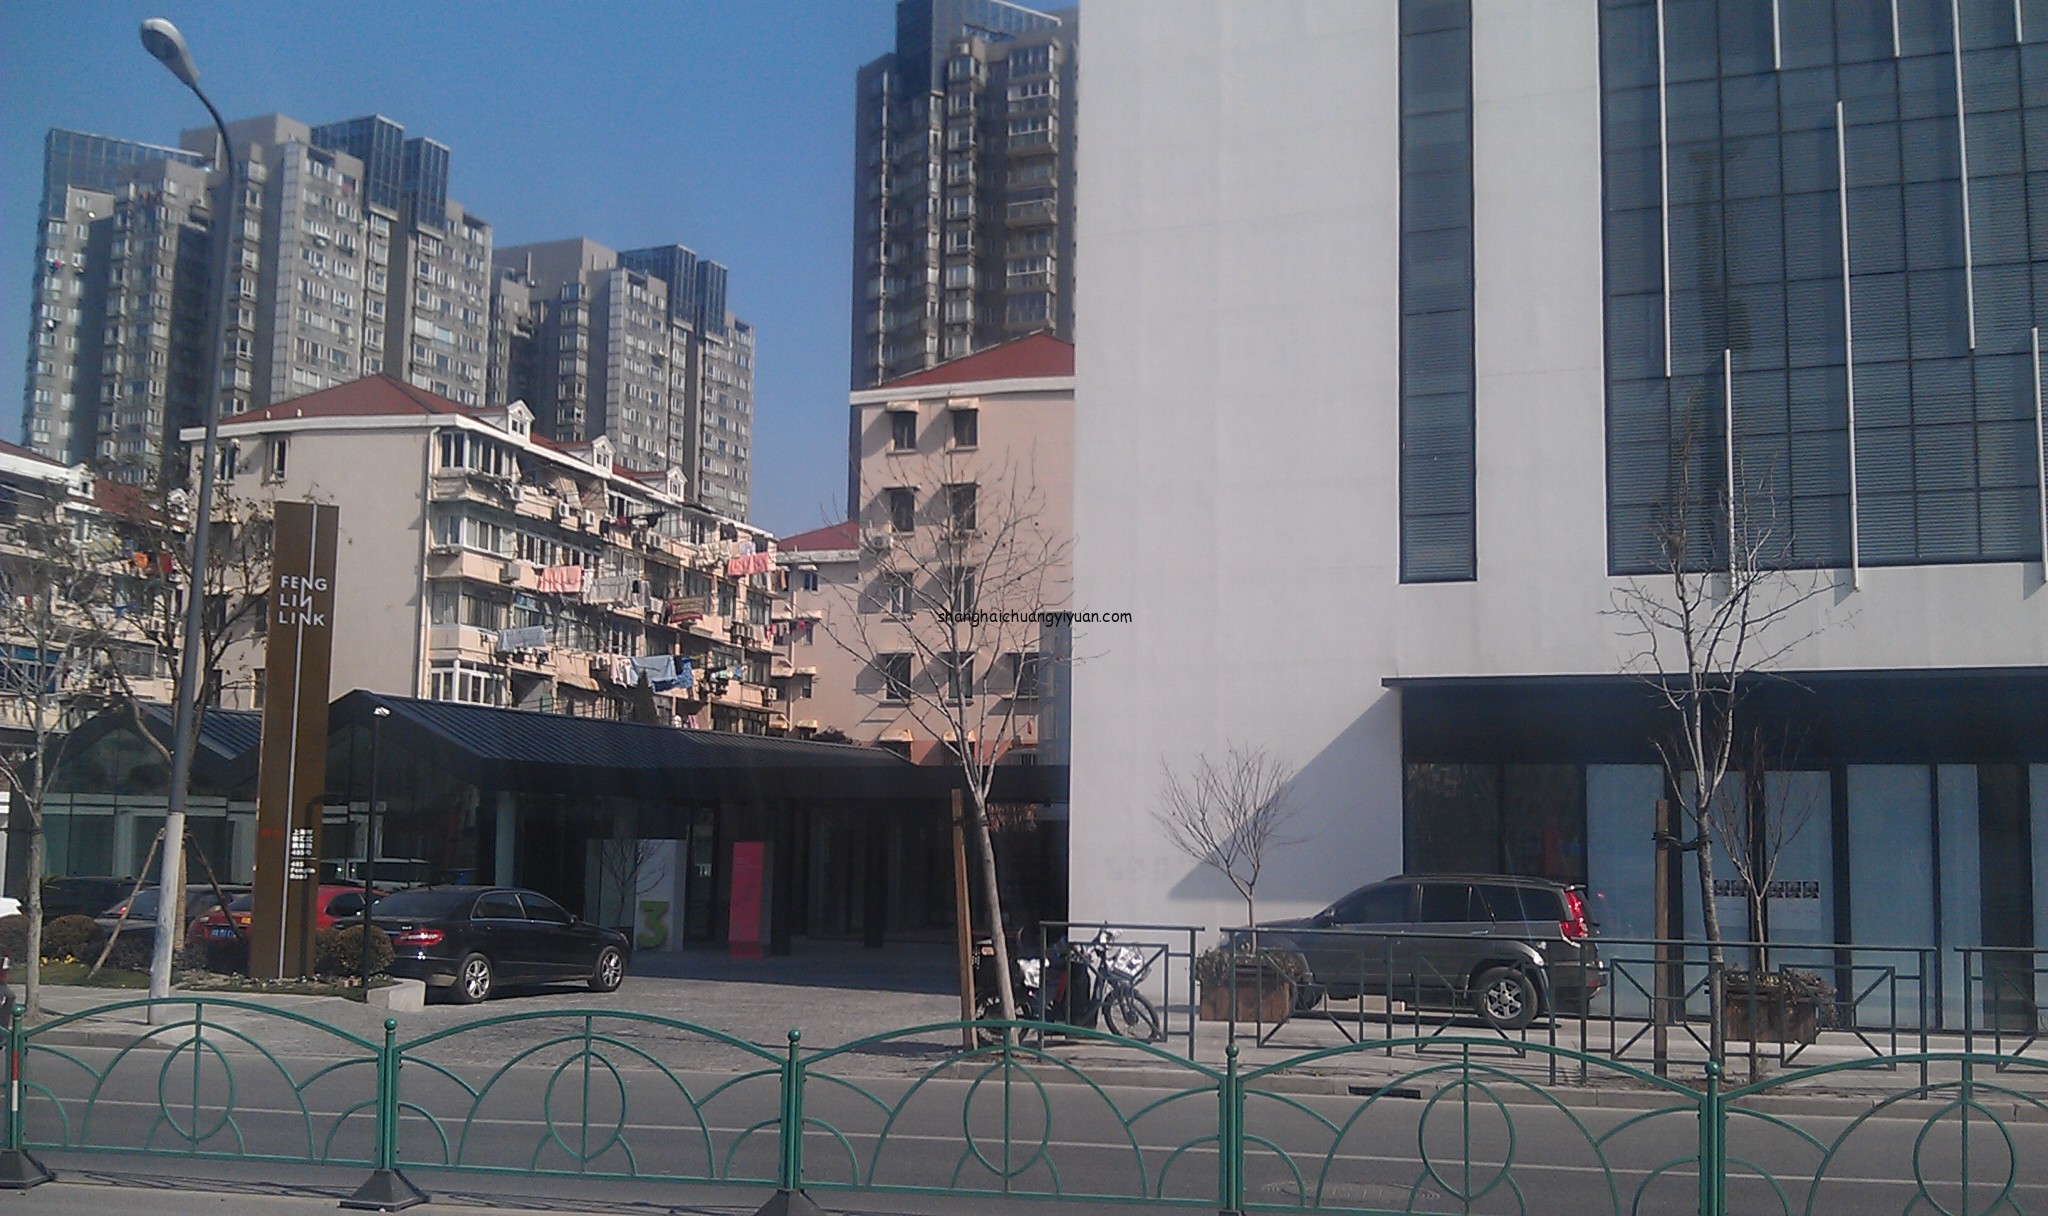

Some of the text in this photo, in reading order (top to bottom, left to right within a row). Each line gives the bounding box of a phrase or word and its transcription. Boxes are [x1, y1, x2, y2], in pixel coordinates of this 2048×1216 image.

[280, 575, 327, 591] FENG
[278, 611, 325, 626] LINK
[638, 900, 670, 949] 3
